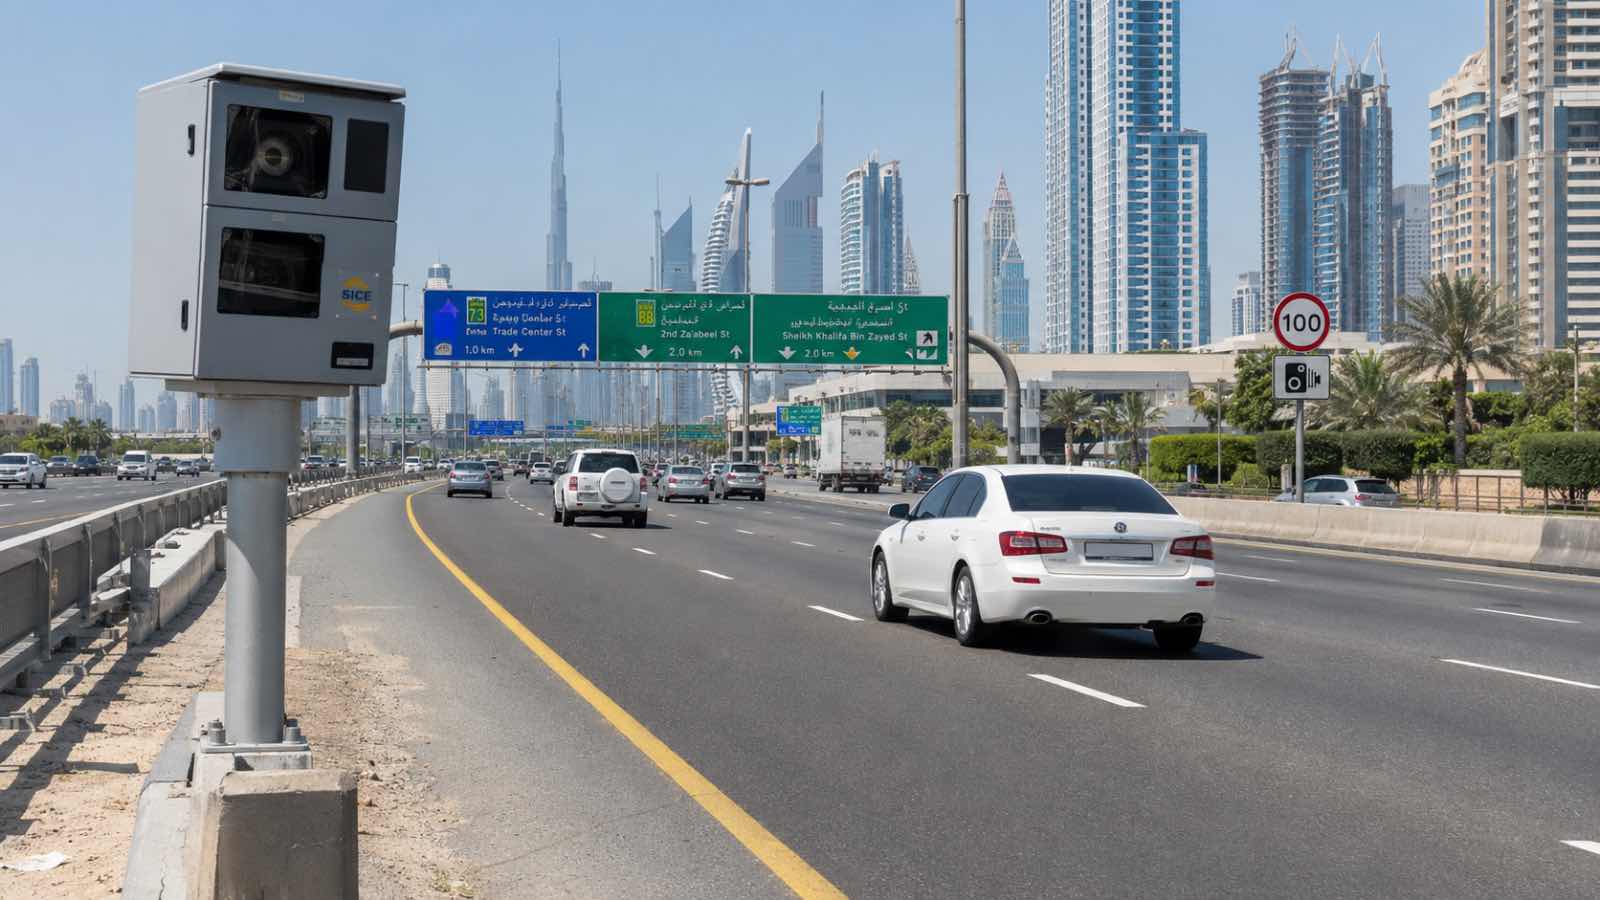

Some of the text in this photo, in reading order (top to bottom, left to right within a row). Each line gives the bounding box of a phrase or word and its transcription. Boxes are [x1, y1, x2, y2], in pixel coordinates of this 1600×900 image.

[341, 289, 373, 301] SICE
[469, 308, 484, 321] 73
[1282, 313, 1321, 332] 100
[492, 327, 518, 336] Trade
[556, 327, 567, 336] St
[661, 329, 678, 338] 2nd
[720, 329, 731, 338] St
[782, 331, 909, 342] Sheikh Khalifa Bin Zayed St
[465, 345, 495, 355] 1.0 km
[688, 347, 703, 357] km
[804, 348, 834, 358] 2.0 km
